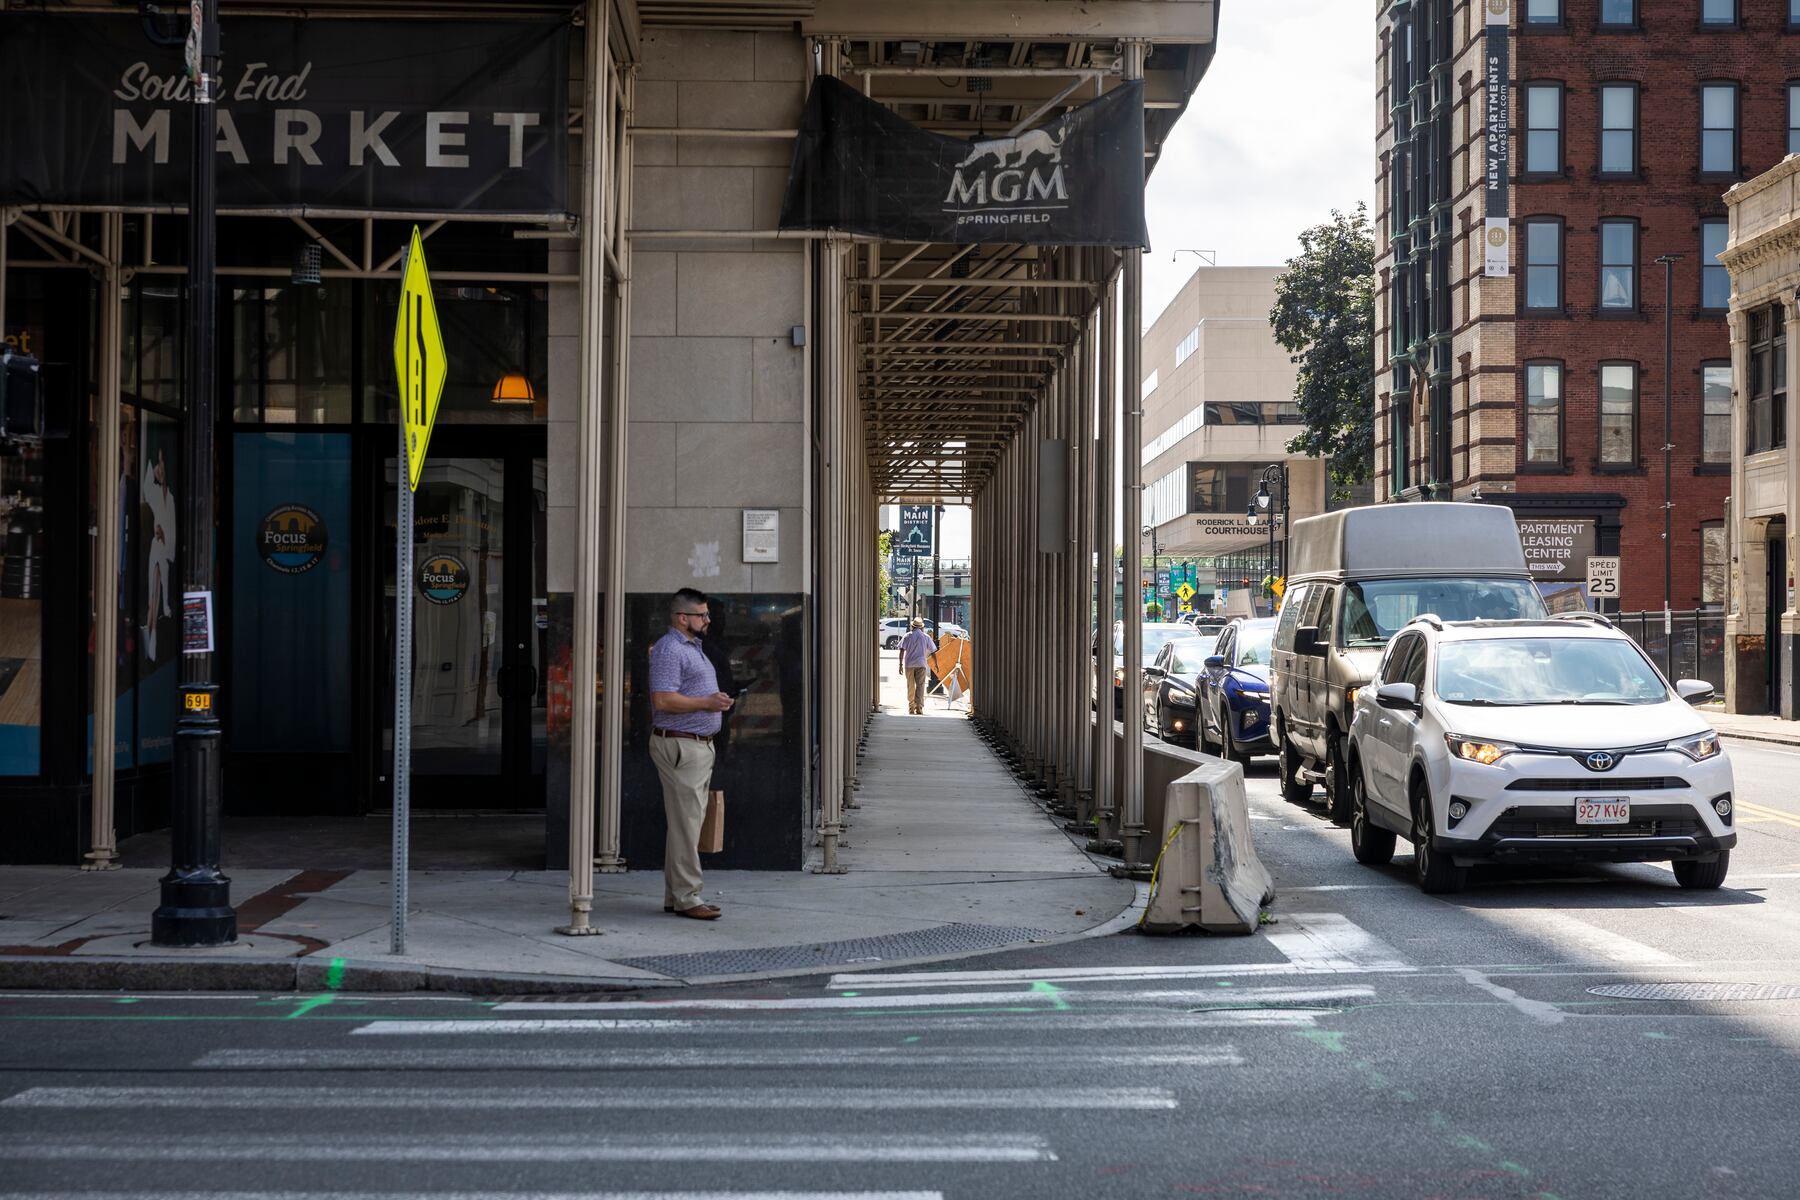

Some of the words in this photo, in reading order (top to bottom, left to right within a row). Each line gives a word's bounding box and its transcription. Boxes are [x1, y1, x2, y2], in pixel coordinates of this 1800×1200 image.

[234, 61, 313, 101] End
[1488, 56, 1498, 152] APARTMENTS
[1498, 84, 1507, 161] Live31Elm.com
[112, 108, 540, 168] MARKET
[1488, 158, 1498, 190] NEW
[943, 165, 1069, 204] MGM
[957, 213, 1051, 225] SPRINGFIELD
[903, 510, 929, 520] MAIN
[1205, 527, 1269, 535] COURTHOUSE
[1518, 524, 1584, 534] PARTMENT
[264, 531, 307, 544] Focus
[1522, 536, 1573, 546] LEASING
[1524, 548, 1571, 559] CENTER
[1590, 561, 1617, 569] SPEED
[422, 573, 455, 583] Focus
[1590, 578, 1616, 593] 25
[186, 695, 209, 707] 69L
[1579, 804, 1601, 818] 927
[1604, 804, 1627, 818] KV6
